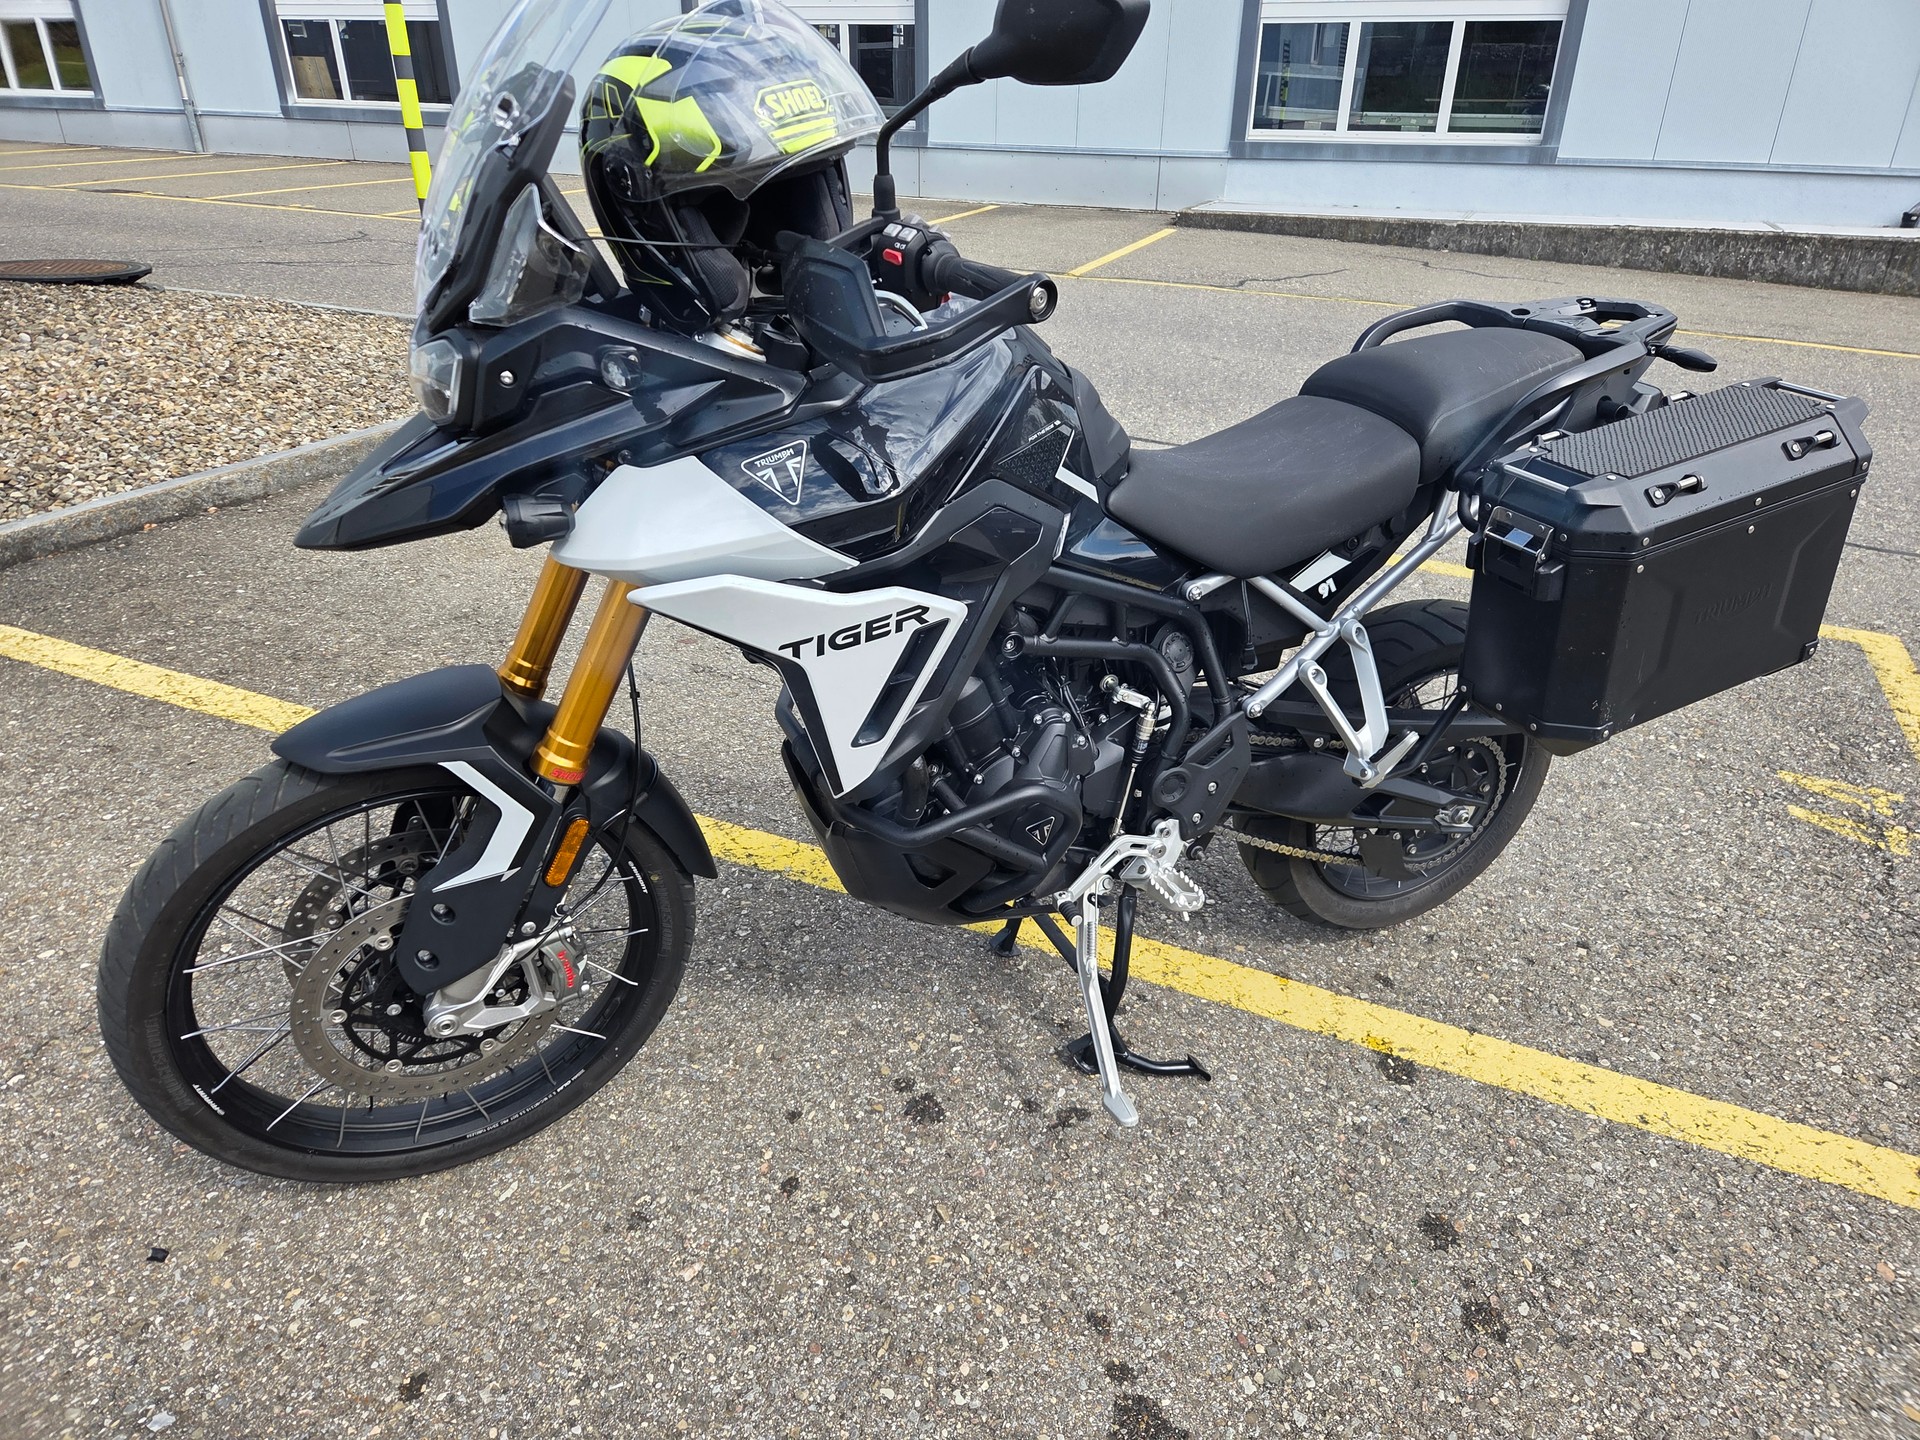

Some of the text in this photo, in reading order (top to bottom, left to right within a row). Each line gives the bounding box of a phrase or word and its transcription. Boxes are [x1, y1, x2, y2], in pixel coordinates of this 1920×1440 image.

[764, 85, 826, 119] SHOEI
[754, 447, 795, 468] TRIUMPH
[1694, 583, 1775, 625] TRIUMPH
[778, 604, 930, 660] TIGER
[552, 768, 586, 781] SHOW
[1430, 816, 1512, 894] BRIDGESTONE
[557, 950, 577, 988] brembo
